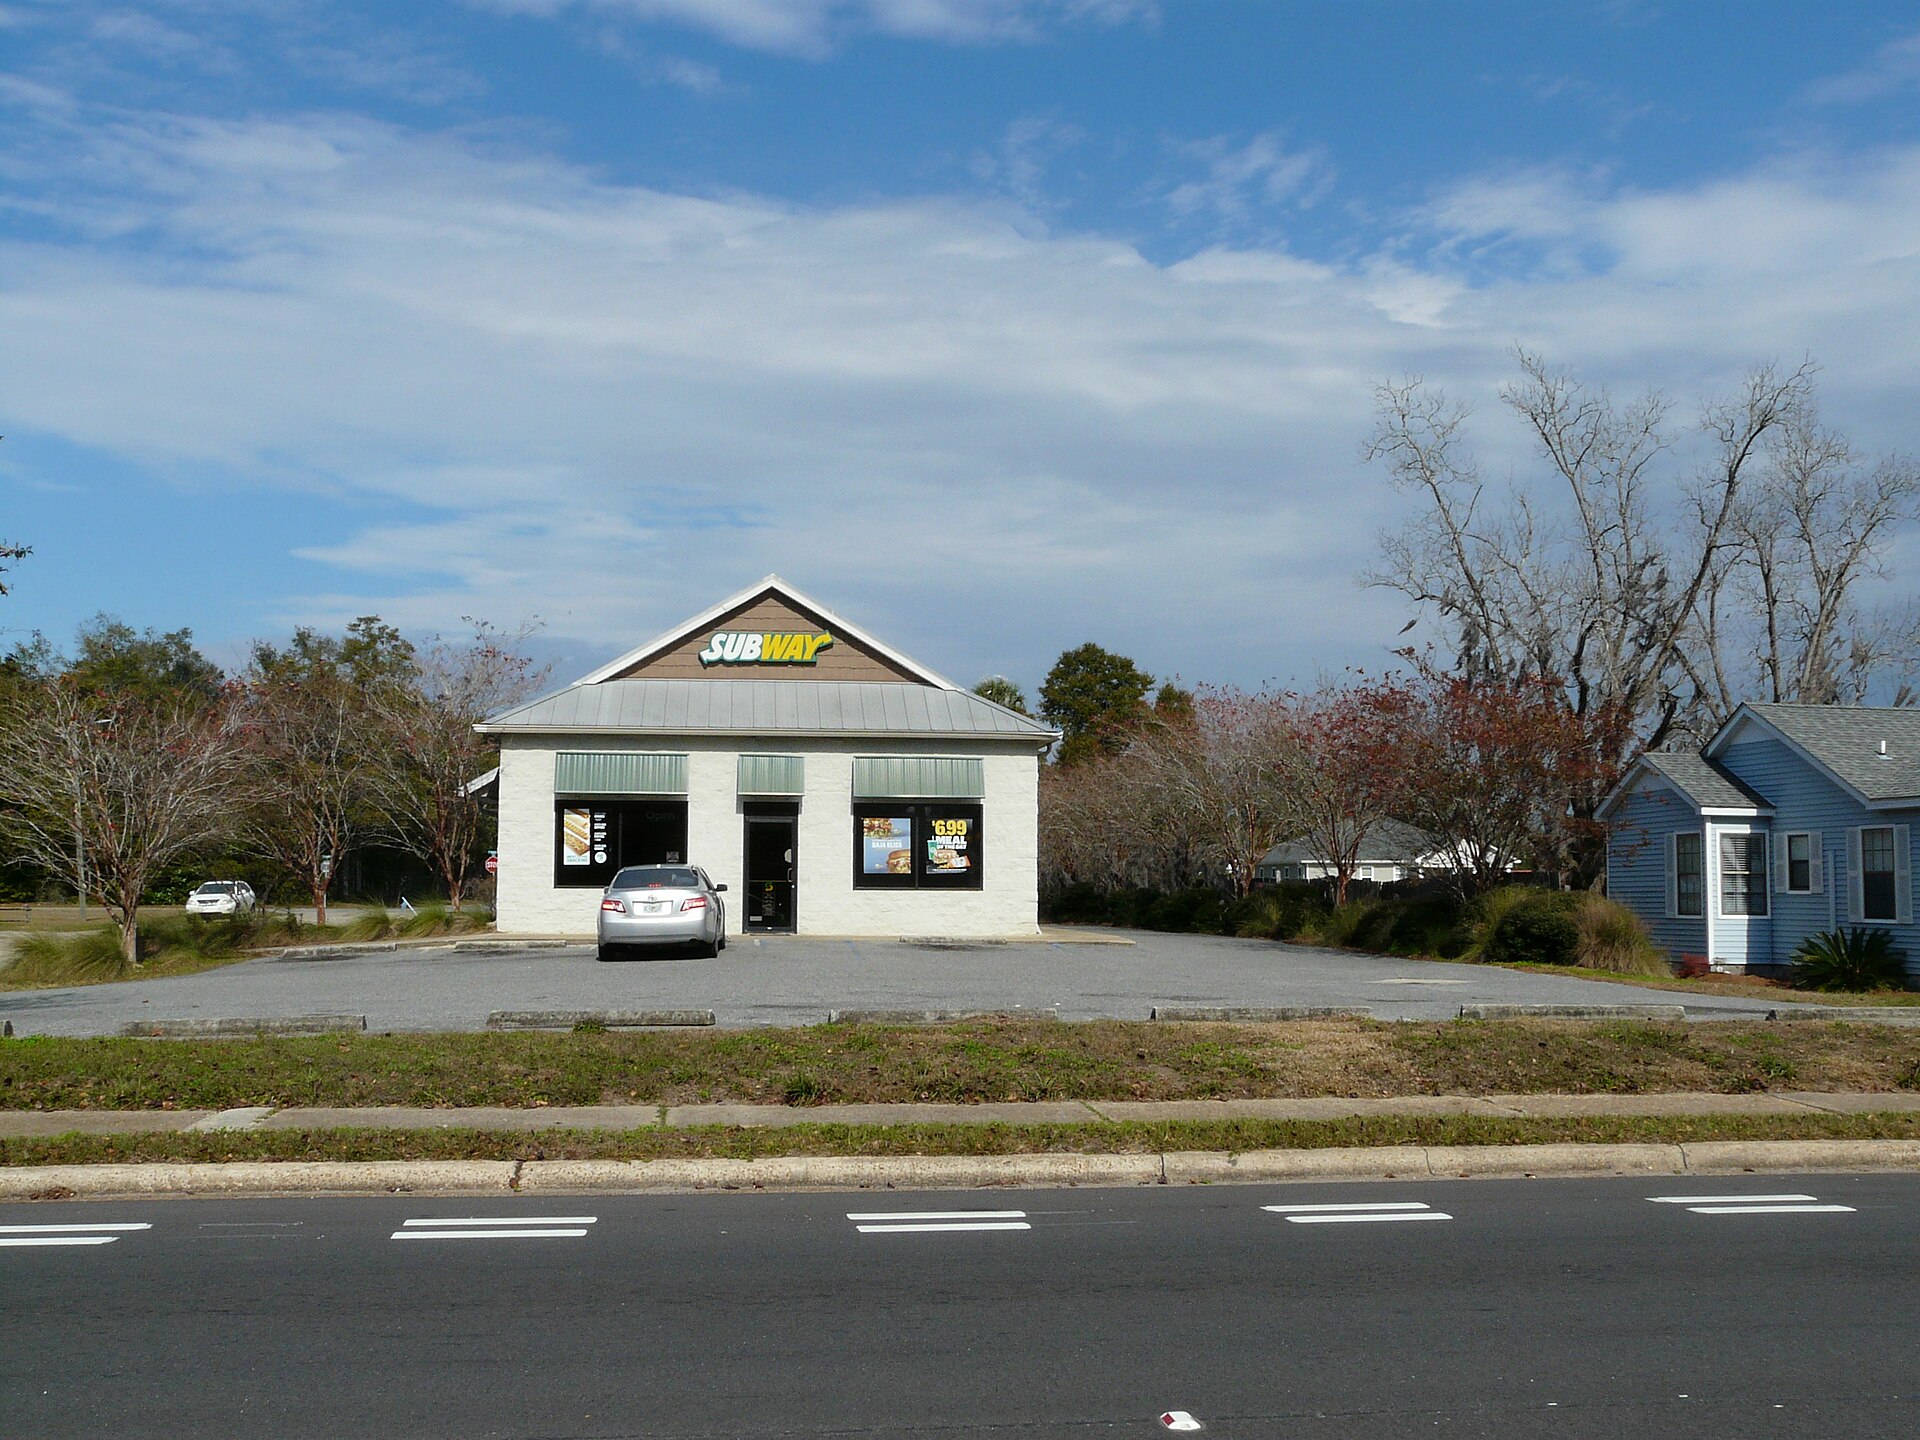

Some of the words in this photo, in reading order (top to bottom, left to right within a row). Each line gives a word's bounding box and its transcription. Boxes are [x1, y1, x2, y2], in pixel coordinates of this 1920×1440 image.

[699, 630, 832, 663] SUBWAY
[646, 811, 676, 822] Open
[931, 820, 967, 836] $6.99
[935, 835, 967, 845] MEAL
